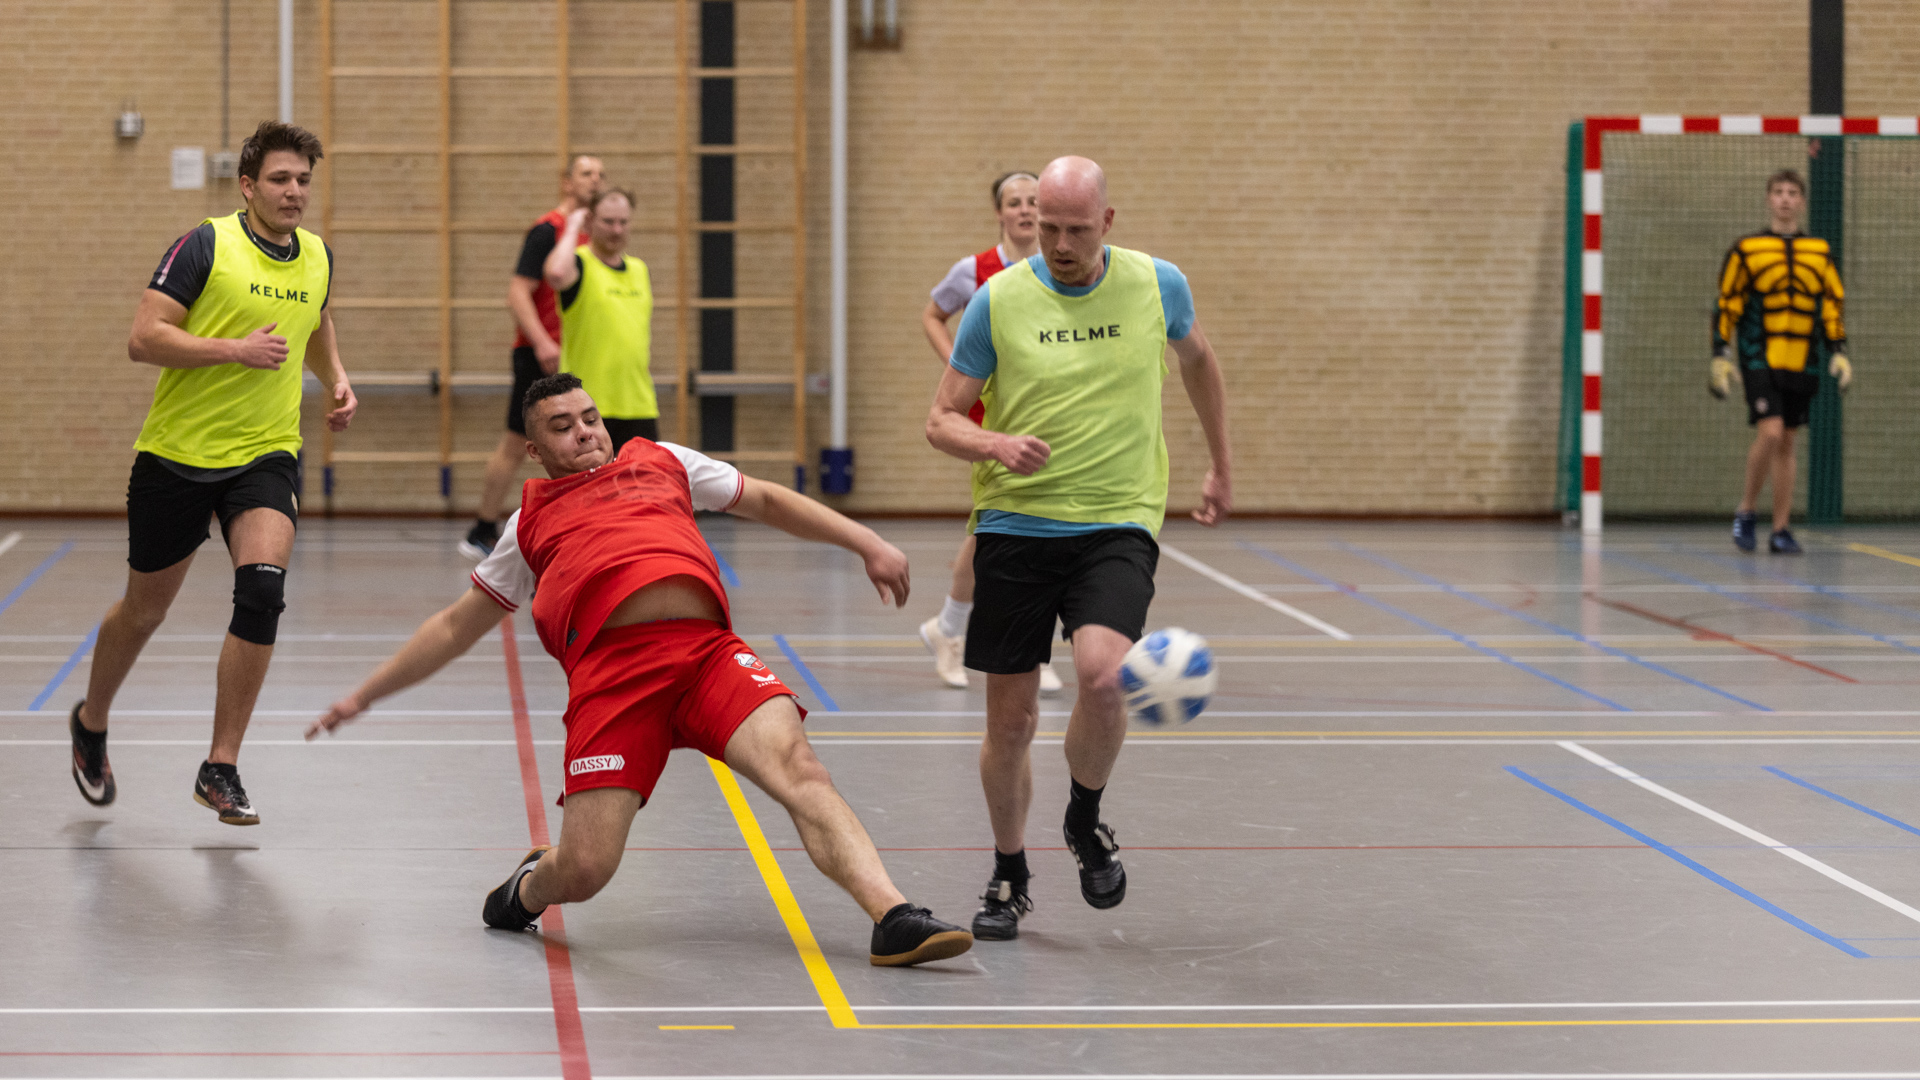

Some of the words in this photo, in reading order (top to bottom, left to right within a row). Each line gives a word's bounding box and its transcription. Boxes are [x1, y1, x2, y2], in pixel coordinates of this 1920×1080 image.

[250, 283, 308, 303] KELME
[1040, 325, 1121, 343] KELME
[572, 757, 612, 773] DASSY
